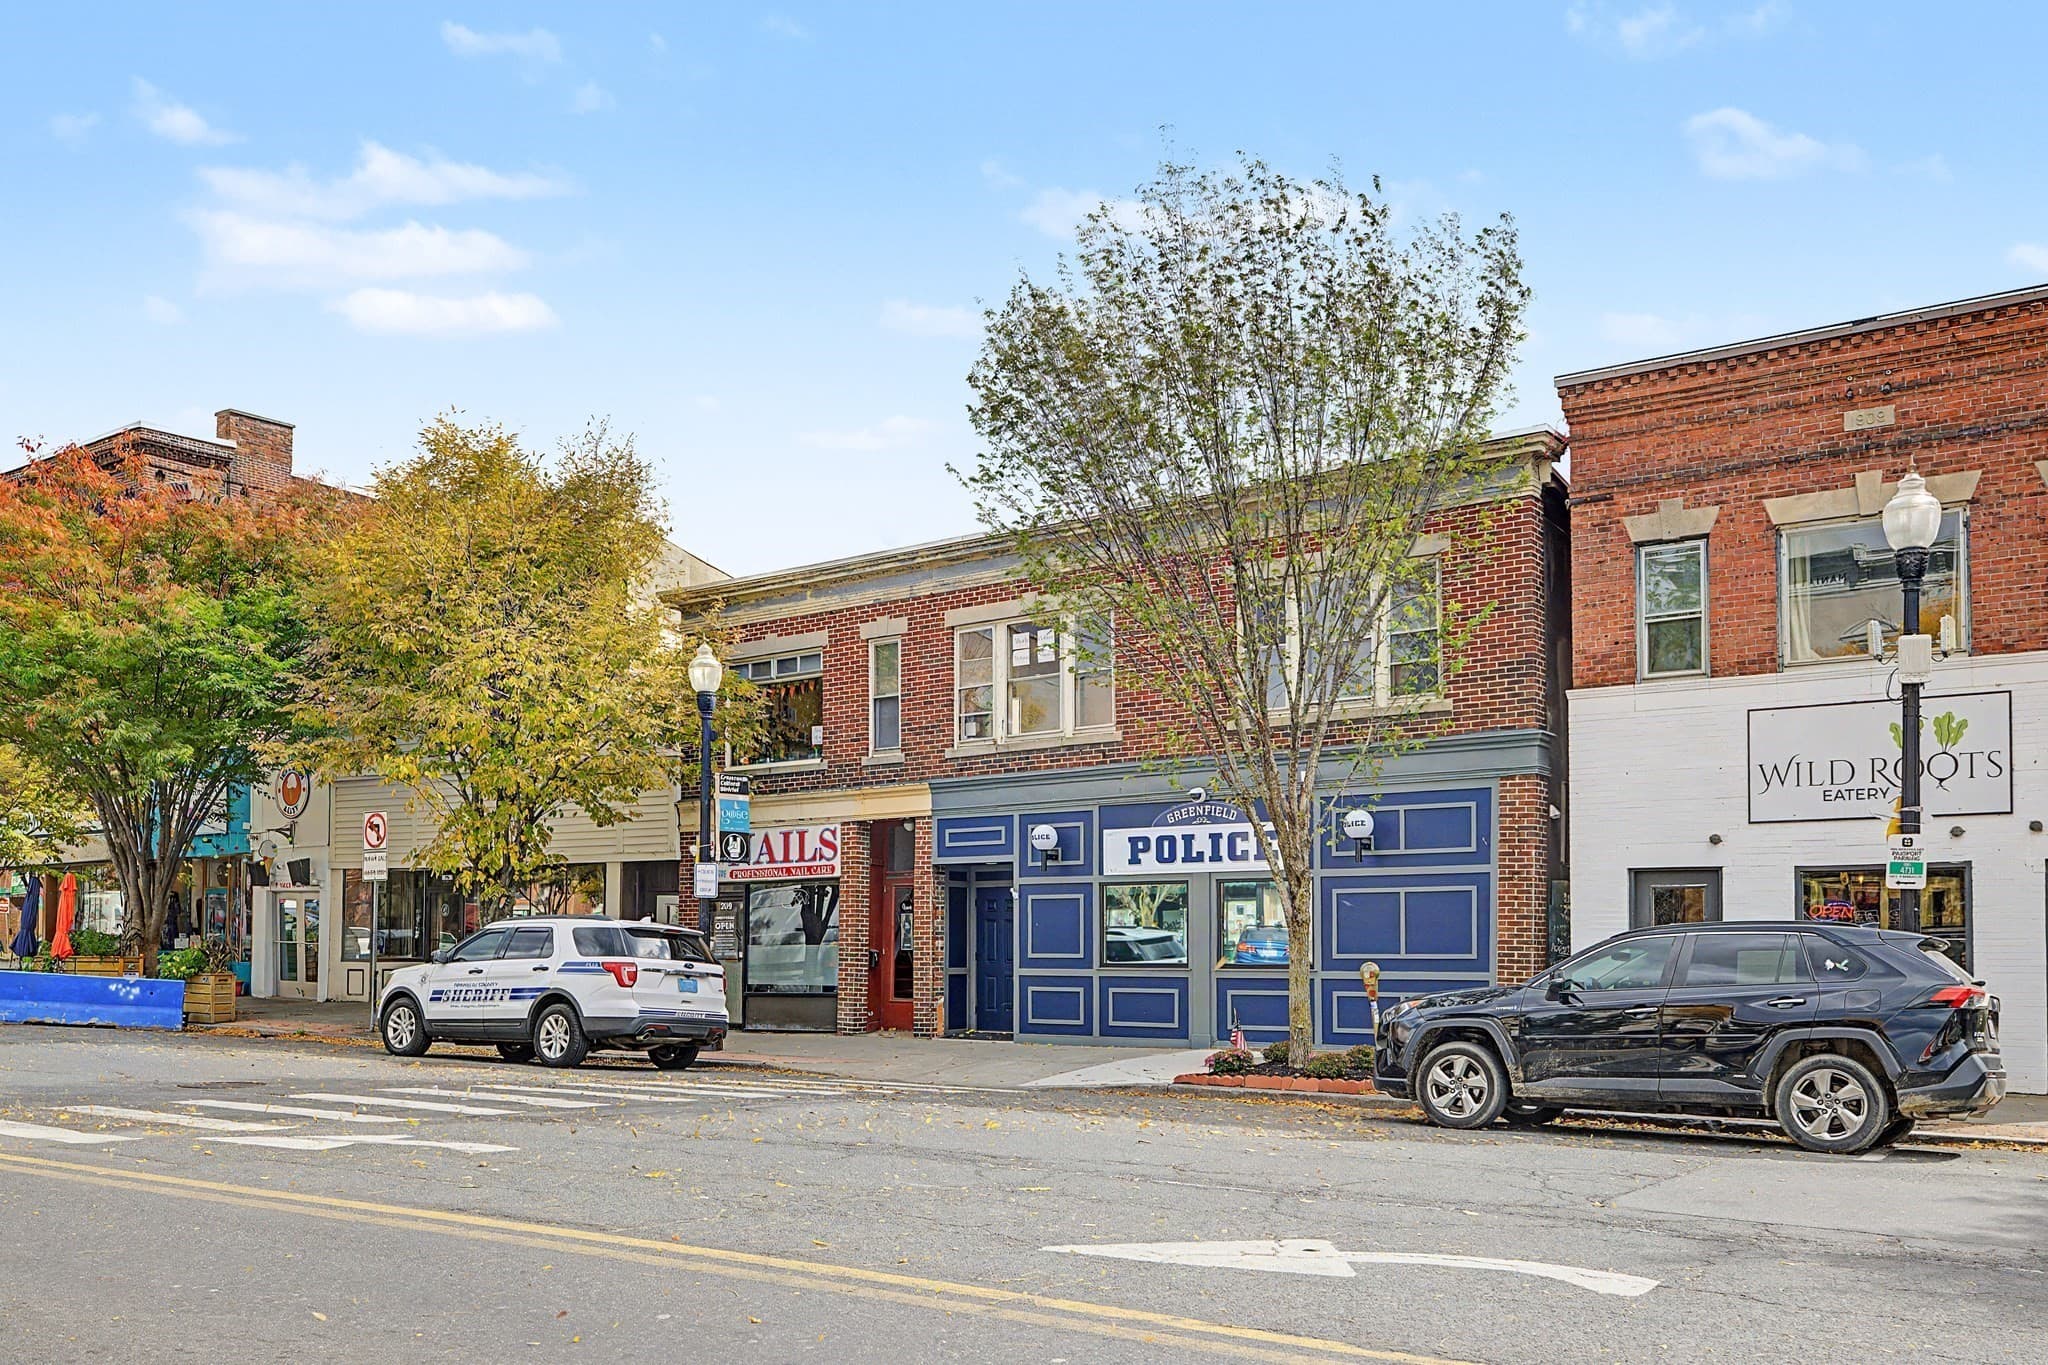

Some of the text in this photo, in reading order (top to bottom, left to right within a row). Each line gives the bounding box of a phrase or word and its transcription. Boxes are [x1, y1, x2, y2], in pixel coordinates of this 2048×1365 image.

[1758, 753, 1856, 795] WILD
[1823, 787, 1890, 801] EATERY
[1166, 804, 1237, 824] GREENFIELD
[750, 826, 838, 865] AILS
[732, 866, 789, 879] PROFESSIONAL
[790, 867, 810, 877] NAIL
[811, 865, 833, 875] CARE
[1809, 904, 1855, 919] OPEN
[442, 988, 510, 1003] SHERIFF
